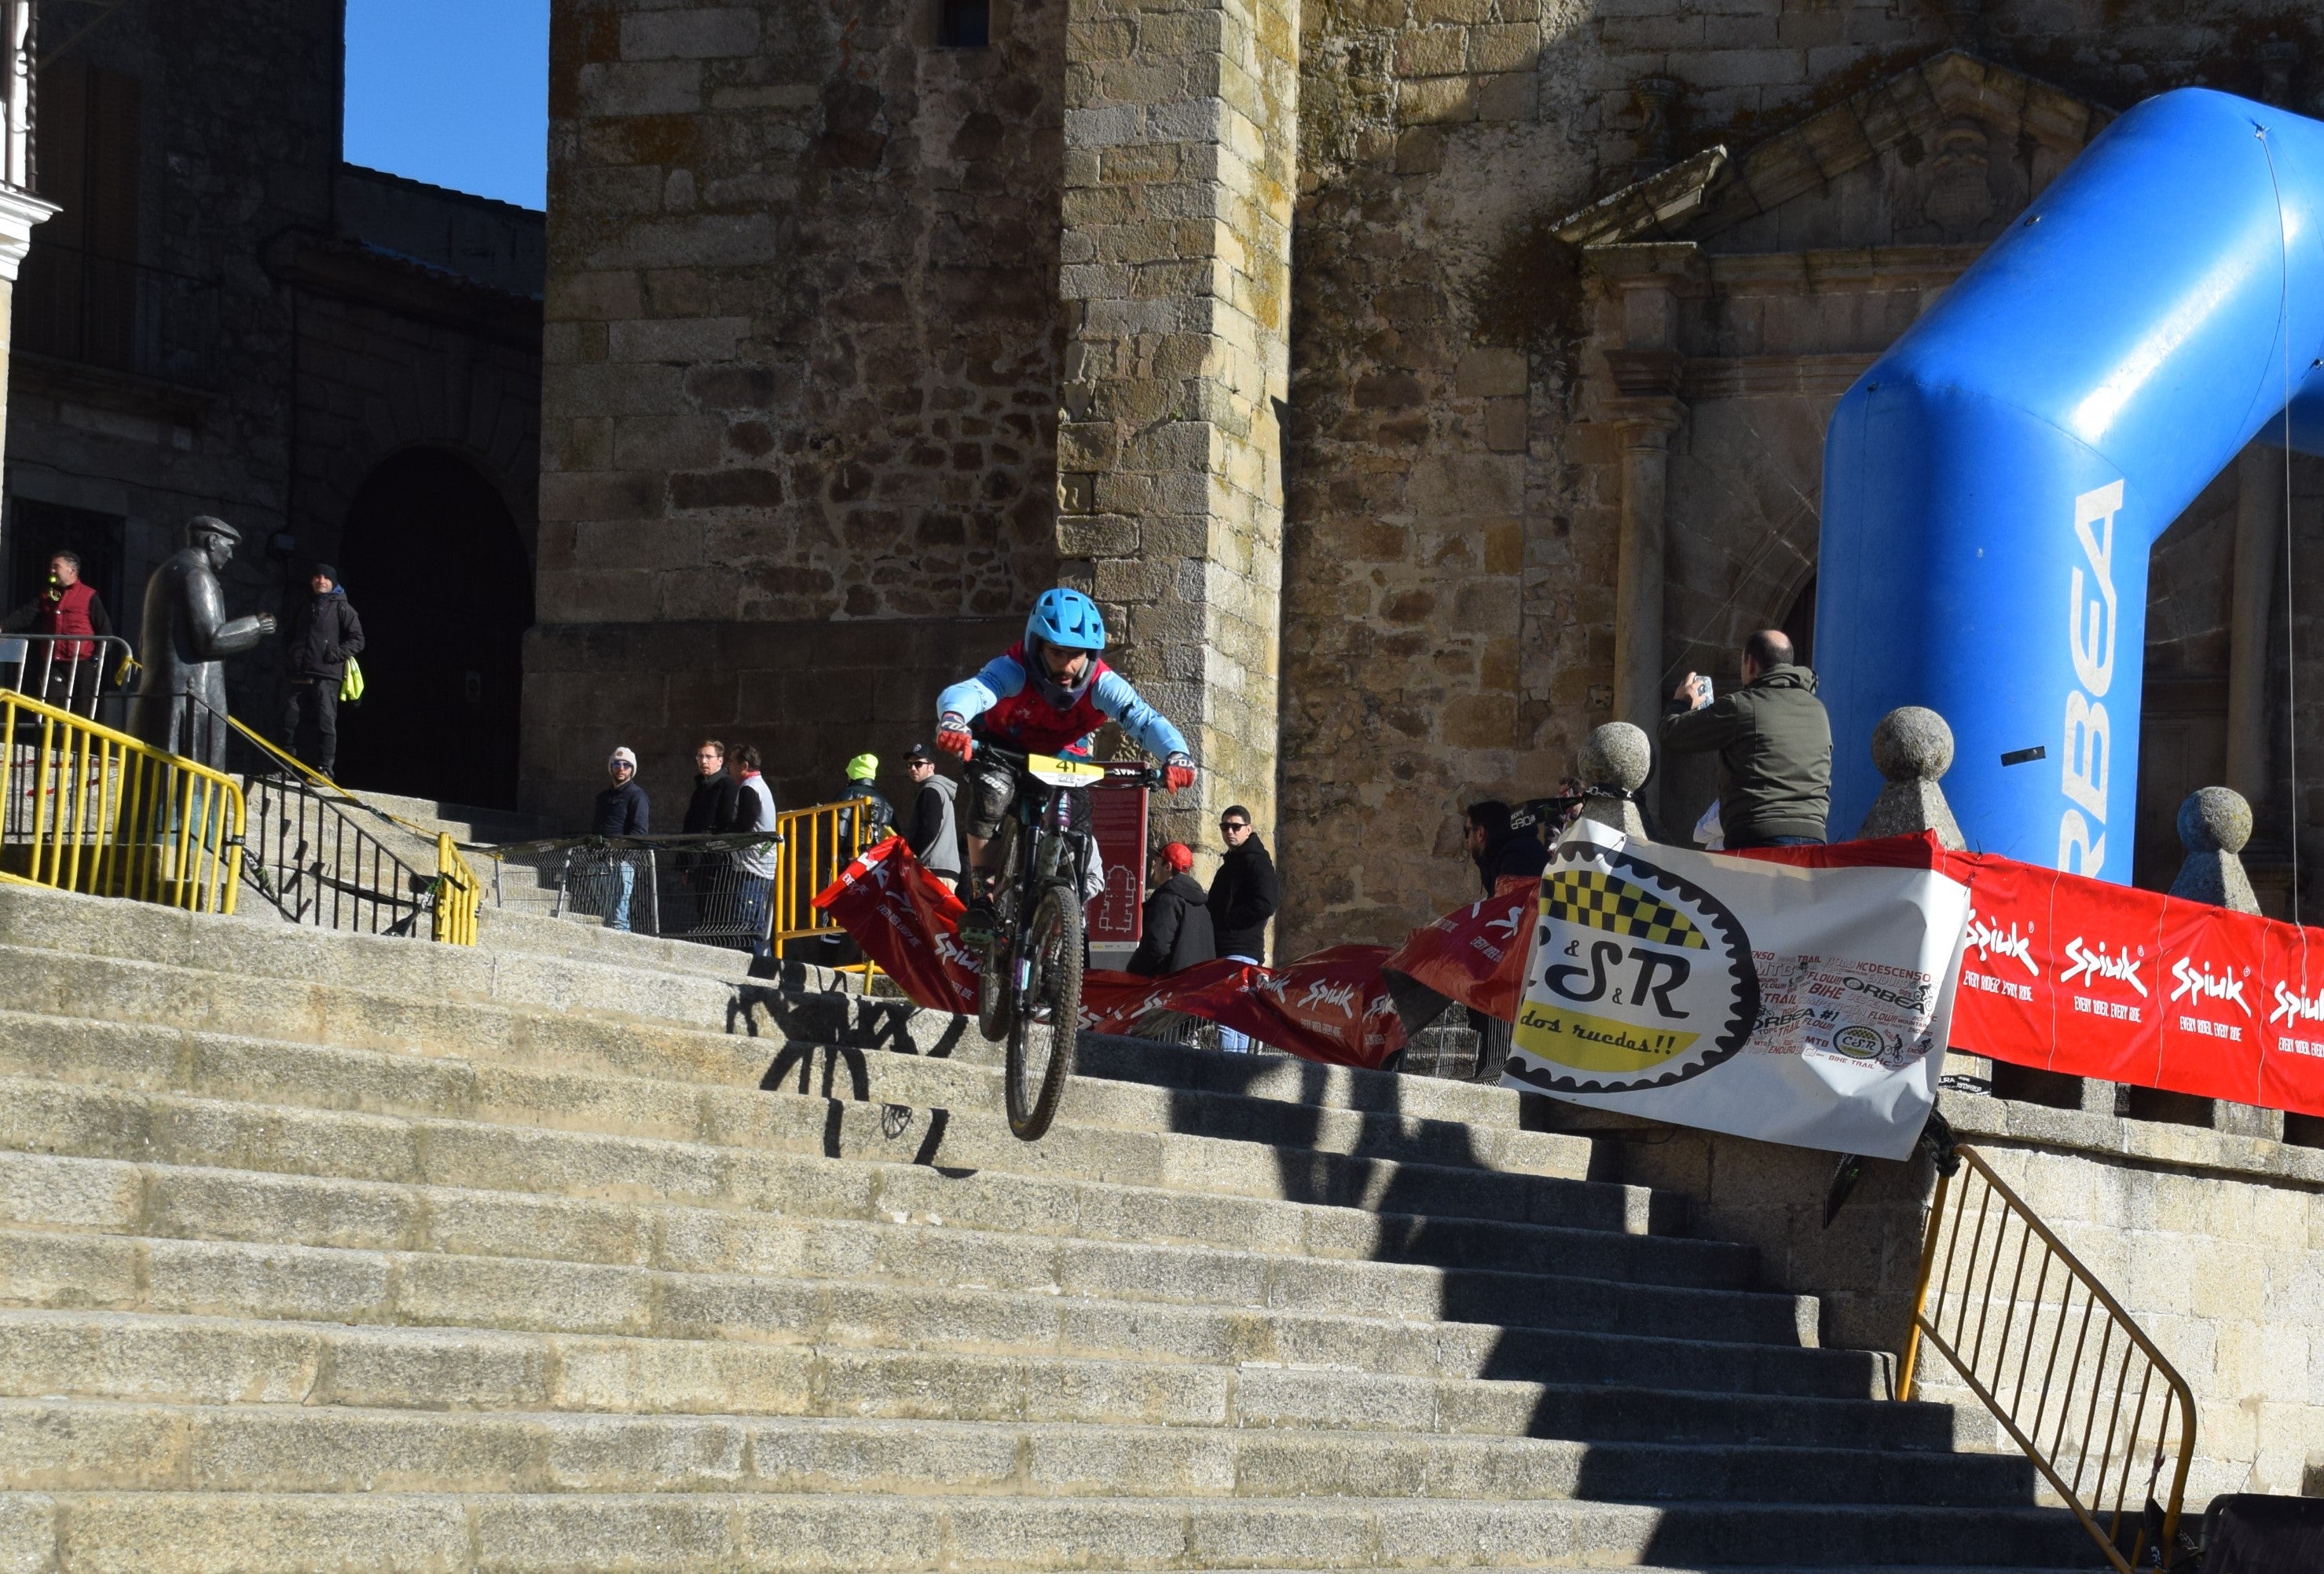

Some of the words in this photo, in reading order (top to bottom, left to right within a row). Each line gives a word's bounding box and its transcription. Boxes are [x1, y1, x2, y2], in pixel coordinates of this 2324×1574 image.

[940, 720, 972, 734] FOX
[1055, 760, 1077, 773] 41
[1170, 759, 1197, 769] FOX
[935, 932, 982, 974] Spiu
[1869, 963, 1931, 983] DESCENSO
[2060, 936, 2148, 998] Spiuk
[1808, 983, 1846, 1000] BIKE
[1842, 976, 1926, 1015] ORBEA
[2170, 957, 2252, 1018] Spiuk
[1764, 993, 1797, 1005] TRAIL
[2074, 995, 2091, 1013] EVERY
[2110, 1003, 2128, 1020] EVERY
[1520, 1010, 1562, 1034] dos
[1819, 1008, 1841, 1022] #1
[2179, 1016, 2196, 1033] EVERY
[2213, 1022, 2230, 1039] EVERY
[1805, 1036, 1830, 1048] MTB
[2278, 1037, 2294, 1052] EVERY
[1851, 1060, 1875, 1070] TRAIL
